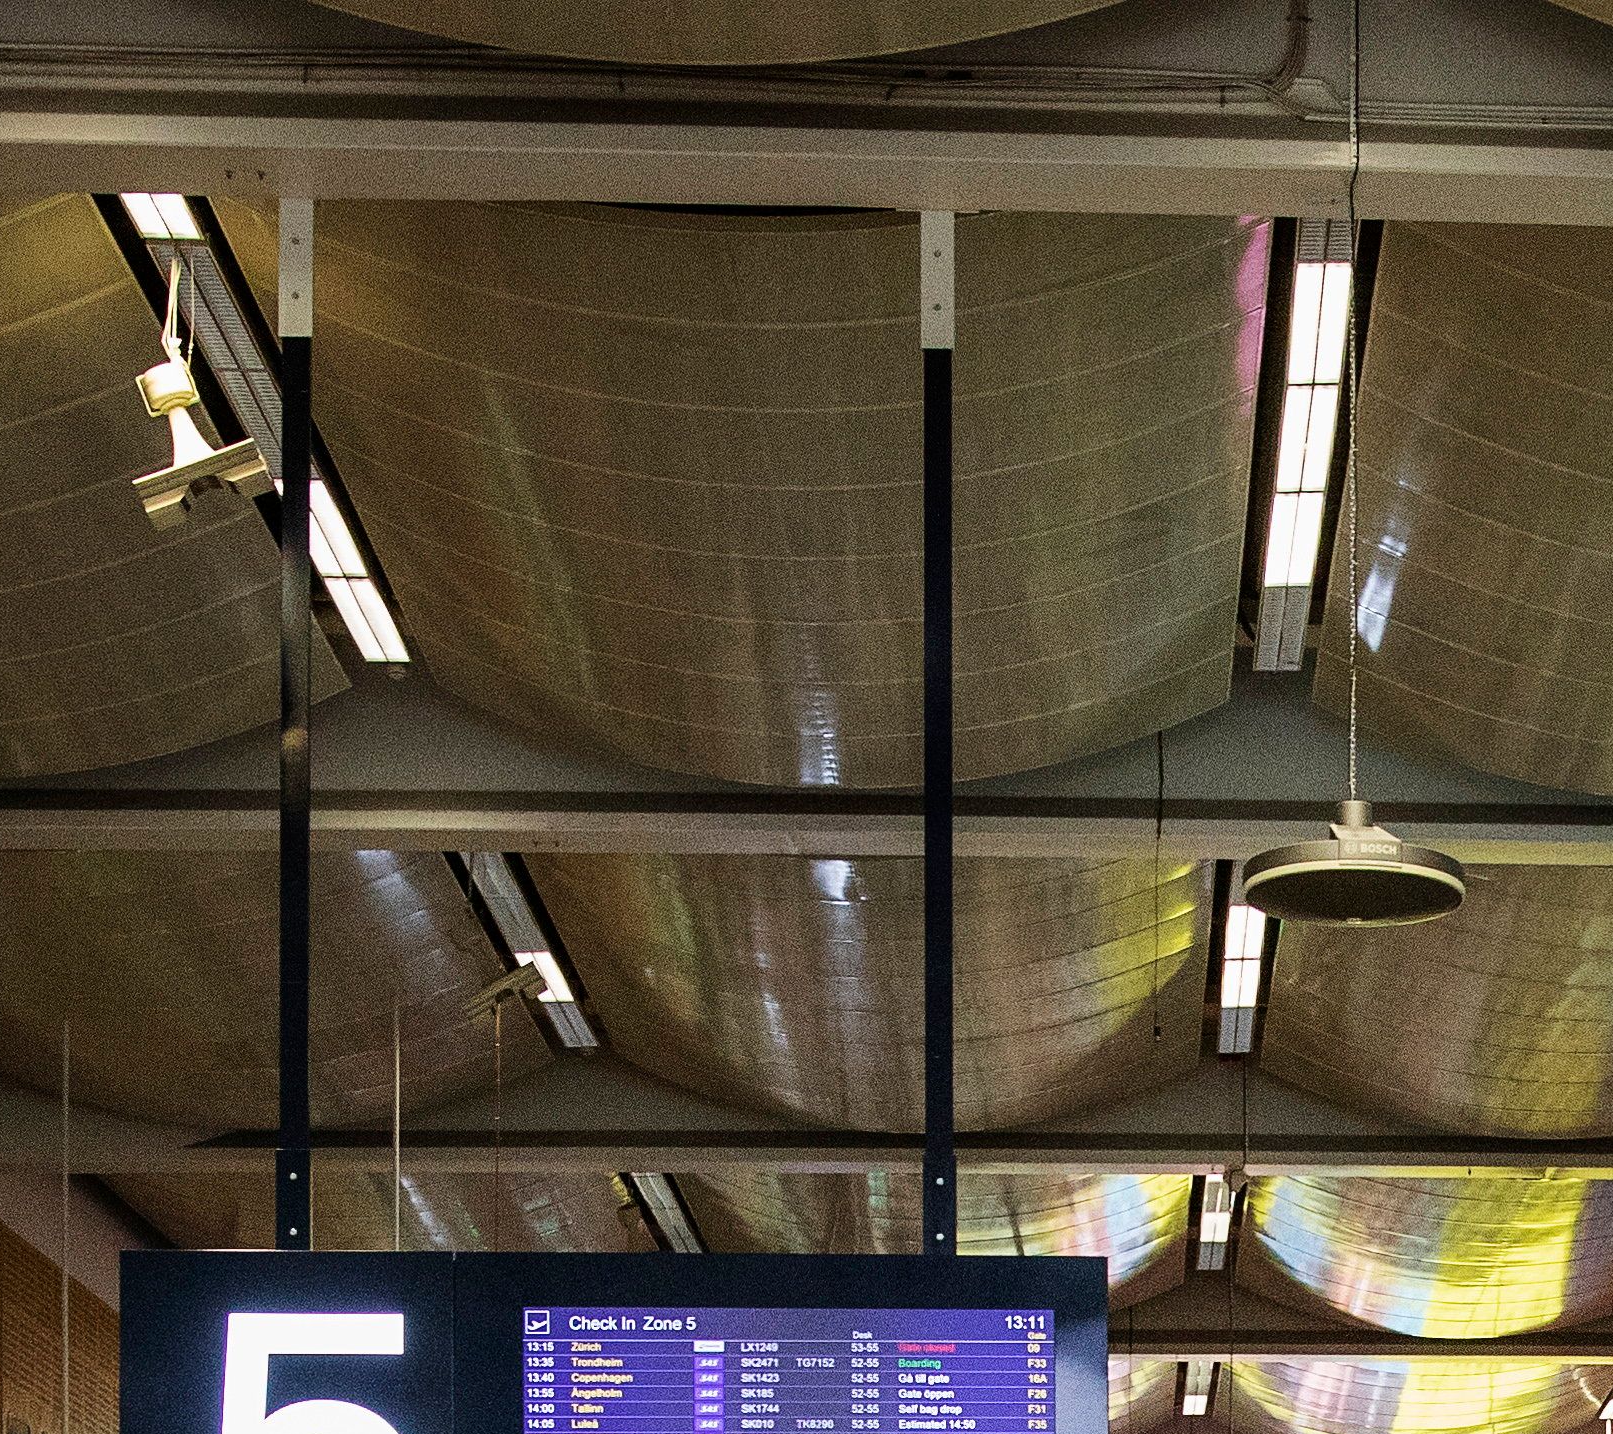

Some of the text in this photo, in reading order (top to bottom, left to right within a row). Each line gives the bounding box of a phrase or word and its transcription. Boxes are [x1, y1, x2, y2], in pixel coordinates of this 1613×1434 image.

[569, 1316, 1045, 1331] Check In Zone 5 13:11
[852, 1331, 873, 1339] Desk
[527, 1359, 554, 1367] 13:35
[741, 1359, 779, 1367] SK2471
[797, 1359, 834, 1367] TG7152
[851, 1359, 879, 1367] 52-55
[898, 1359, 941, 1369] Boarding
[527, 1374, 554, 1382] 13:40
[571, 1374, 633, 1385] Copenhagen
[741, 1374, 780, 1382] SK1423
[852, 1374, 879, 1382] 52-55
[928, 1374, 949, 1385] gate
